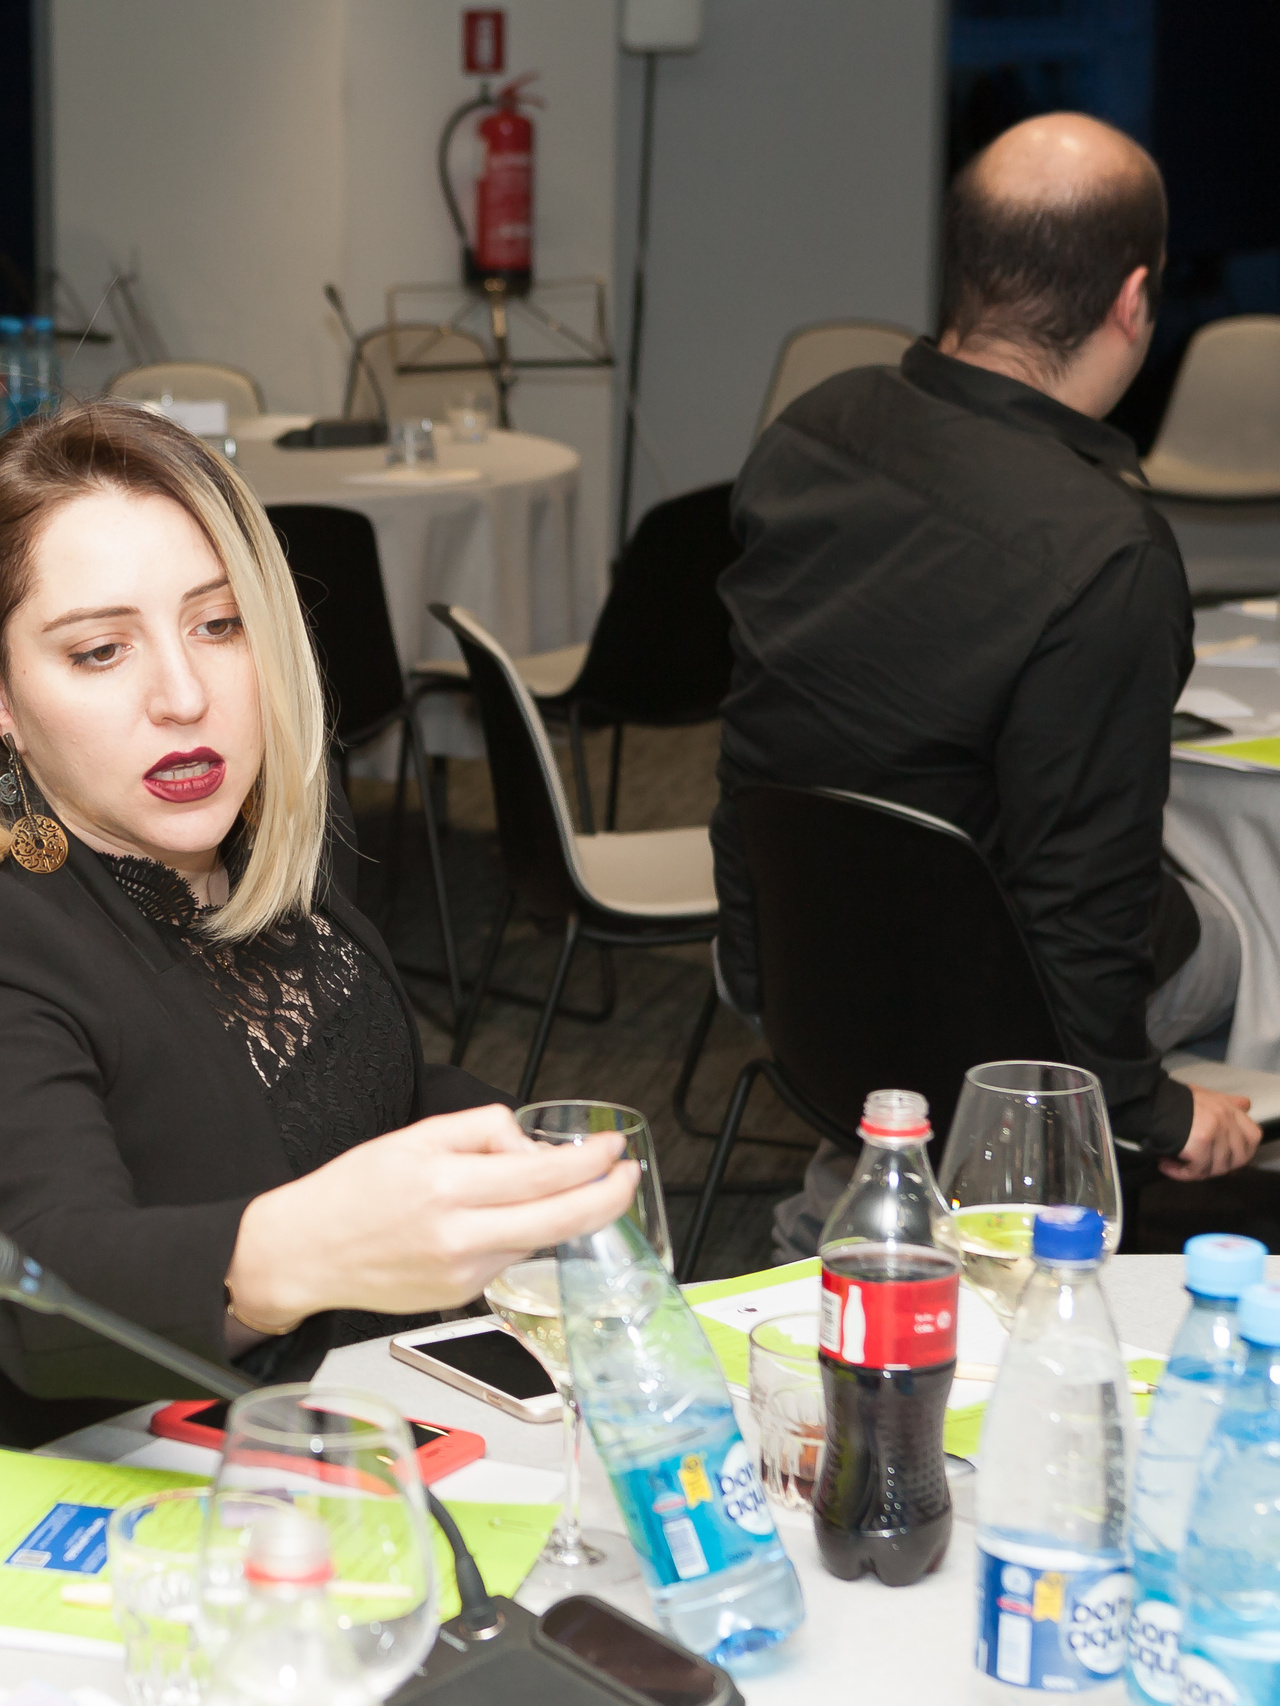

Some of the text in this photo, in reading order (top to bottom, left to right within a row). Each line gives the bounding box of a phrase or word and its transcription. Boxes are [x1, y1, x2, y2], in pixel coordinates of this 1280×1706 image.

[724, 1490, 767, 1522] aqu
[1067, 1625, 1127, 1651] aqu
[1126, 1632, 1178, 1678] aqu
